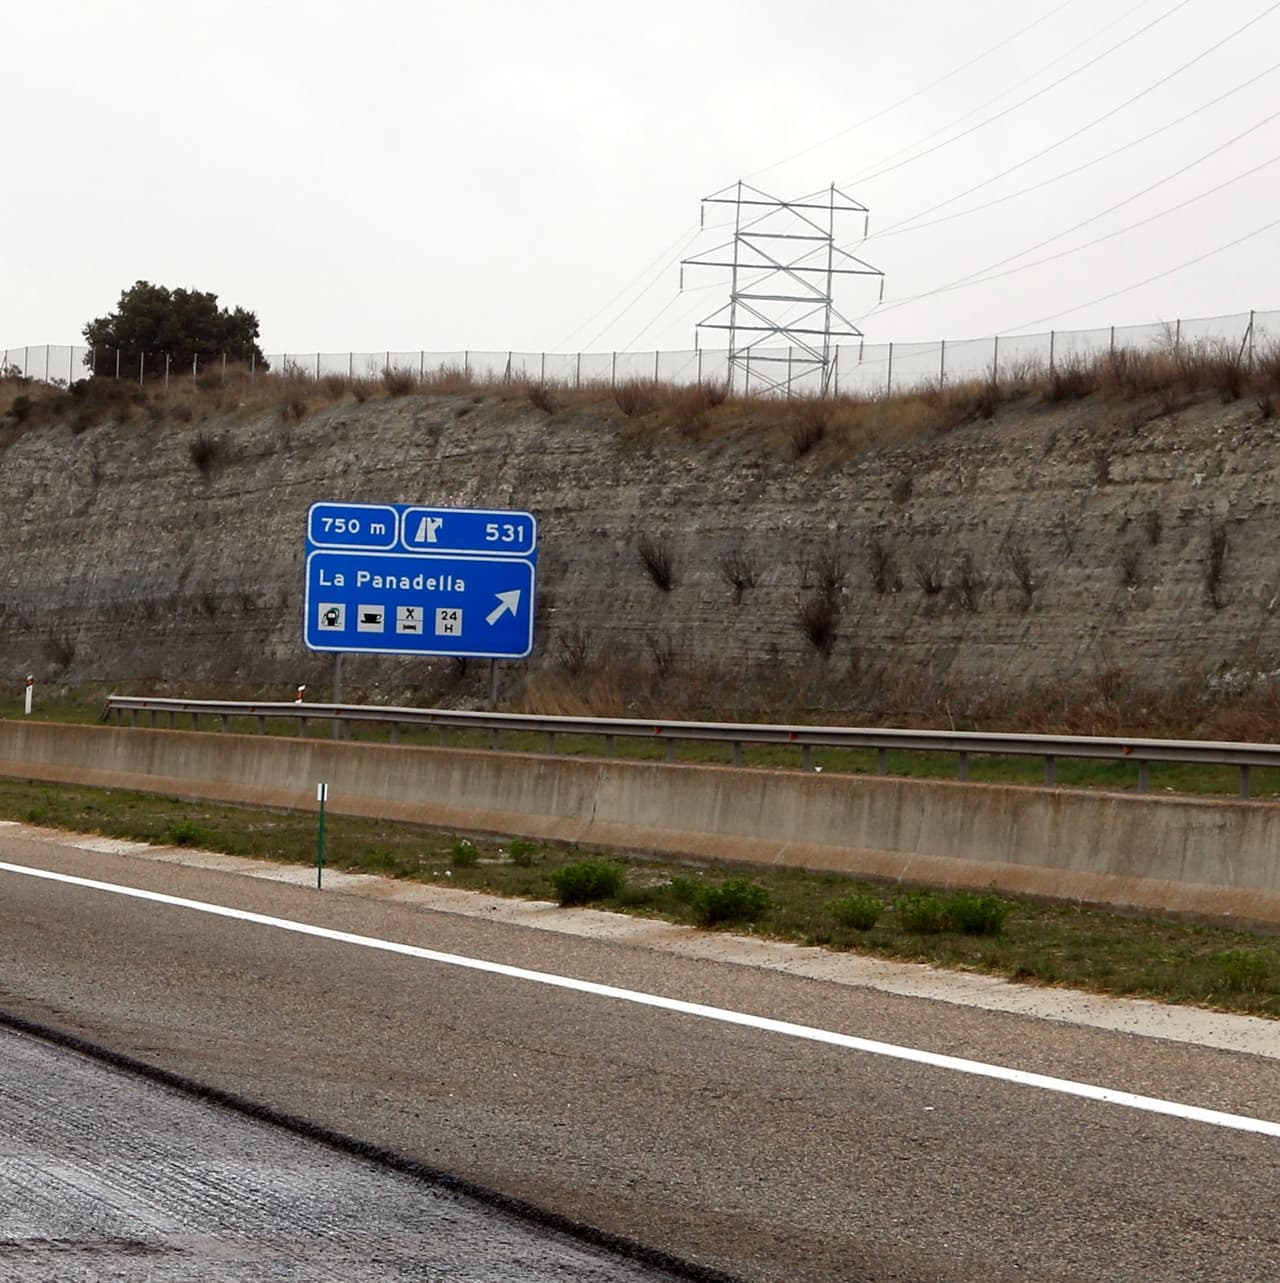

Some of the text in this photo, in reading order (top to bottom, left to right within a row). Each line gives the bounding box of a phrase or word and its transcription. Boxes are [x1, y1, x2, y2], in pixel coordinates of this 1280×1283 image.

[322, 517, 385, 535] 750 m
[485, 523, 524, 543] 531
[319, 569, 465, 592] La Panadella
[441, 610, 457, 621] 24
[444, 623, 453, 633] H
